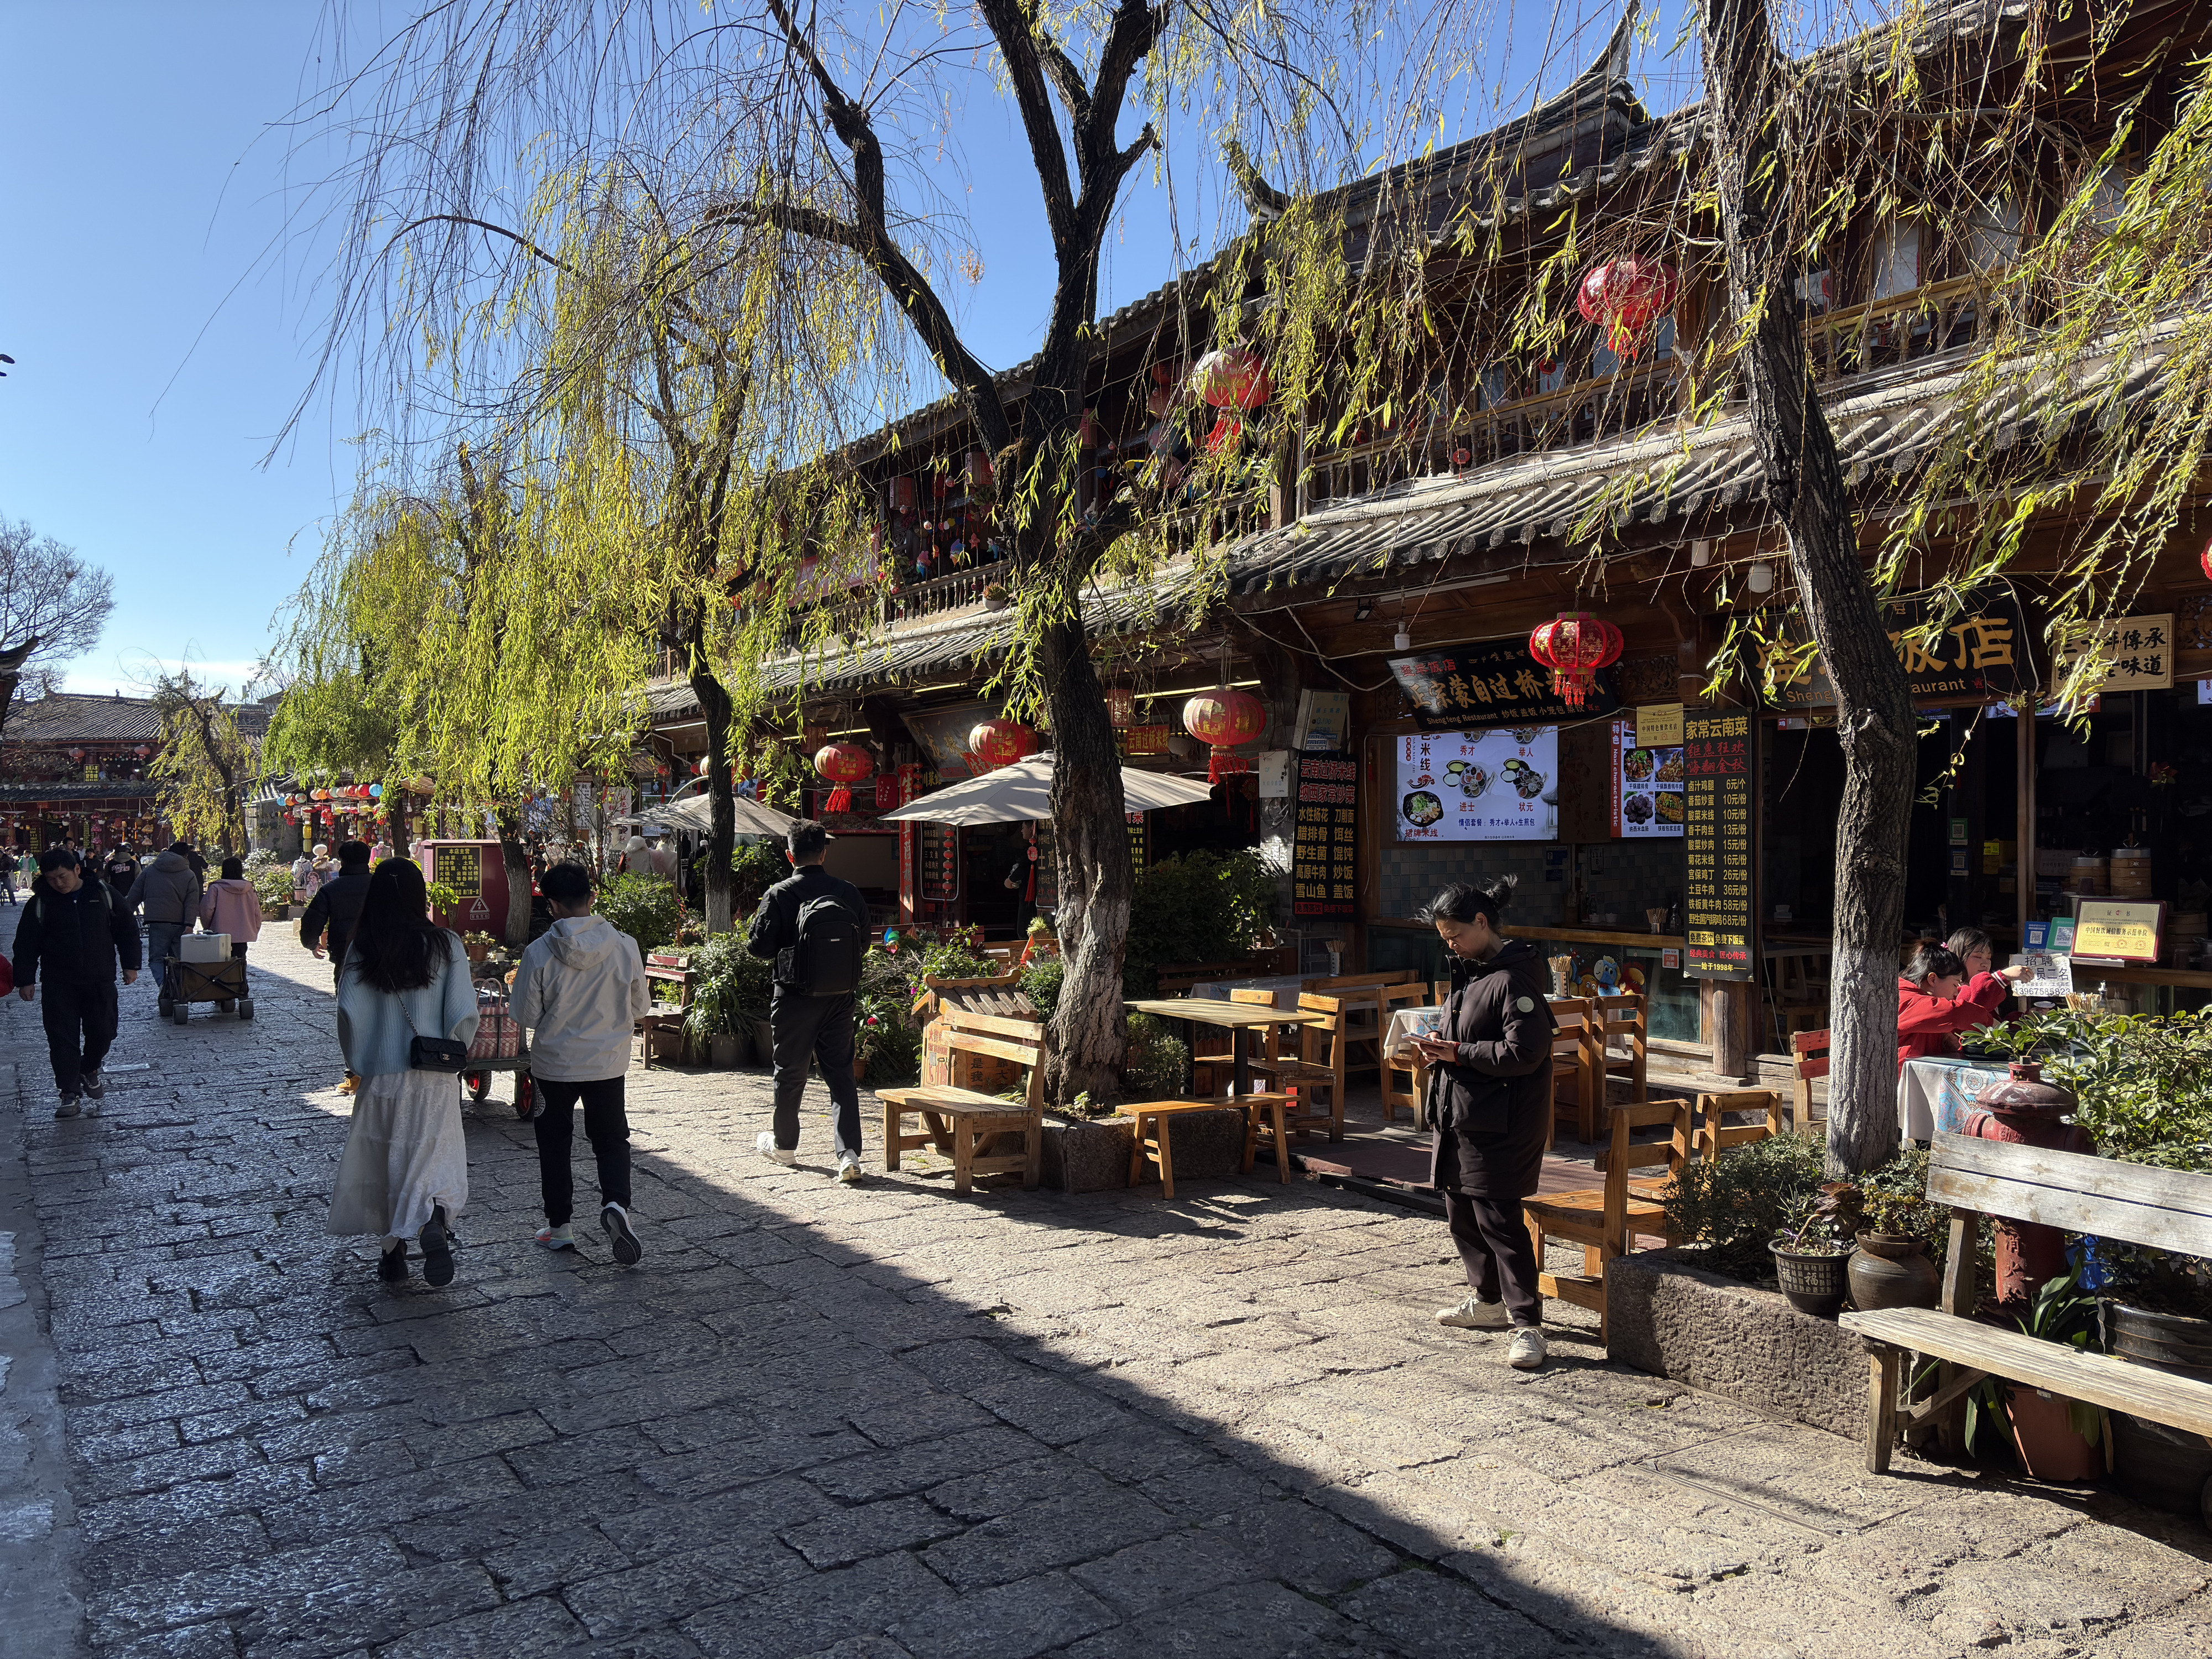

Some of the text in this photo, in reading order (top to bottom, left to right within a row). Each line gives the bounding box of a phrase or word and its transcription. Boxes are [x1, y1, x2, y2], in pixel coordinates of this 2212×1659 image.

[1462, 712, 1498, 722] Restaurant
[1501, 708, 1519, 719] 炒饭
[1520, 707, 1537, 718] 盖饭
[1539, 705, 1564, 716] 小笼包
[1642, 723, 1677, 732] 中国特色餐饮名店
[1686, 716, 1748, 739] 家常云南菜
[1128, 728, 1169, 750] 云南过桥米线
[1460, 745, 1475, 756] 秀才
[1519, 747, 1533, 758] 举人
[1301, 759, 1357, 781] 云南过桥米线
[1688, 778, 1746, 792] 卤汁鸡腿 6元/个
[1300, 782, 1355, 805] 纳西家常炒菜
[1688, 794, 1747, 806] 番茄炒蛋 10元/份
[1459, 801, 1475, 812] 进士
[1519, 801, 1533, 812] 状元
[1298, 806, 1354, 823] 水性杨花 刀削面
[1688, 808, 1747, 821] 酸菜米线 10元/份
[1489, 818, 1535, 827] 秀才+举人+生煎包
[1297, 826, 1354, 842] 腊排骨 饵丝
[1405, 828, 1438, 838] 招牌米线
[1688, 823, 1747, 836] 香干肉丝 13元/份
[1688, 839, 1747, 851] 酸菜炒肉 15元/份
[1296, 845, 1353, 861] 野生菌 馄饨
[1038, 848, 1055, 871] 土鸡
[1688, 854, 1747, 865] 菊花米线 16元/份
[1296, 864, 1353, 880] 高原牛肉 炒饭
[1688, 869, 1747, 881] 宫保鸡丁 26元/份
[1295, 883, 1354, 899] 雪山鱼 盖饭
[1688, 884, 1747, 896] 土豆牛肉 36元/份
[1688, 899, 1747, 911] 铁板黄牛肉 58元/份
[1688, 914, 1747, 926] 野生菌汽锅鸡 68元/份
[2085, 926, 2148, 936] 中国餐饮诚信服务示范单位
[1690, 932, 1745, 946] 免费茶饮 免费下饭菜
[1689, 949, 1746, 961] 经典美食 匠心传承
[2025, 955, 2053, 967] 招聘
[1781, 1267, 1818, 1286] 福 福
